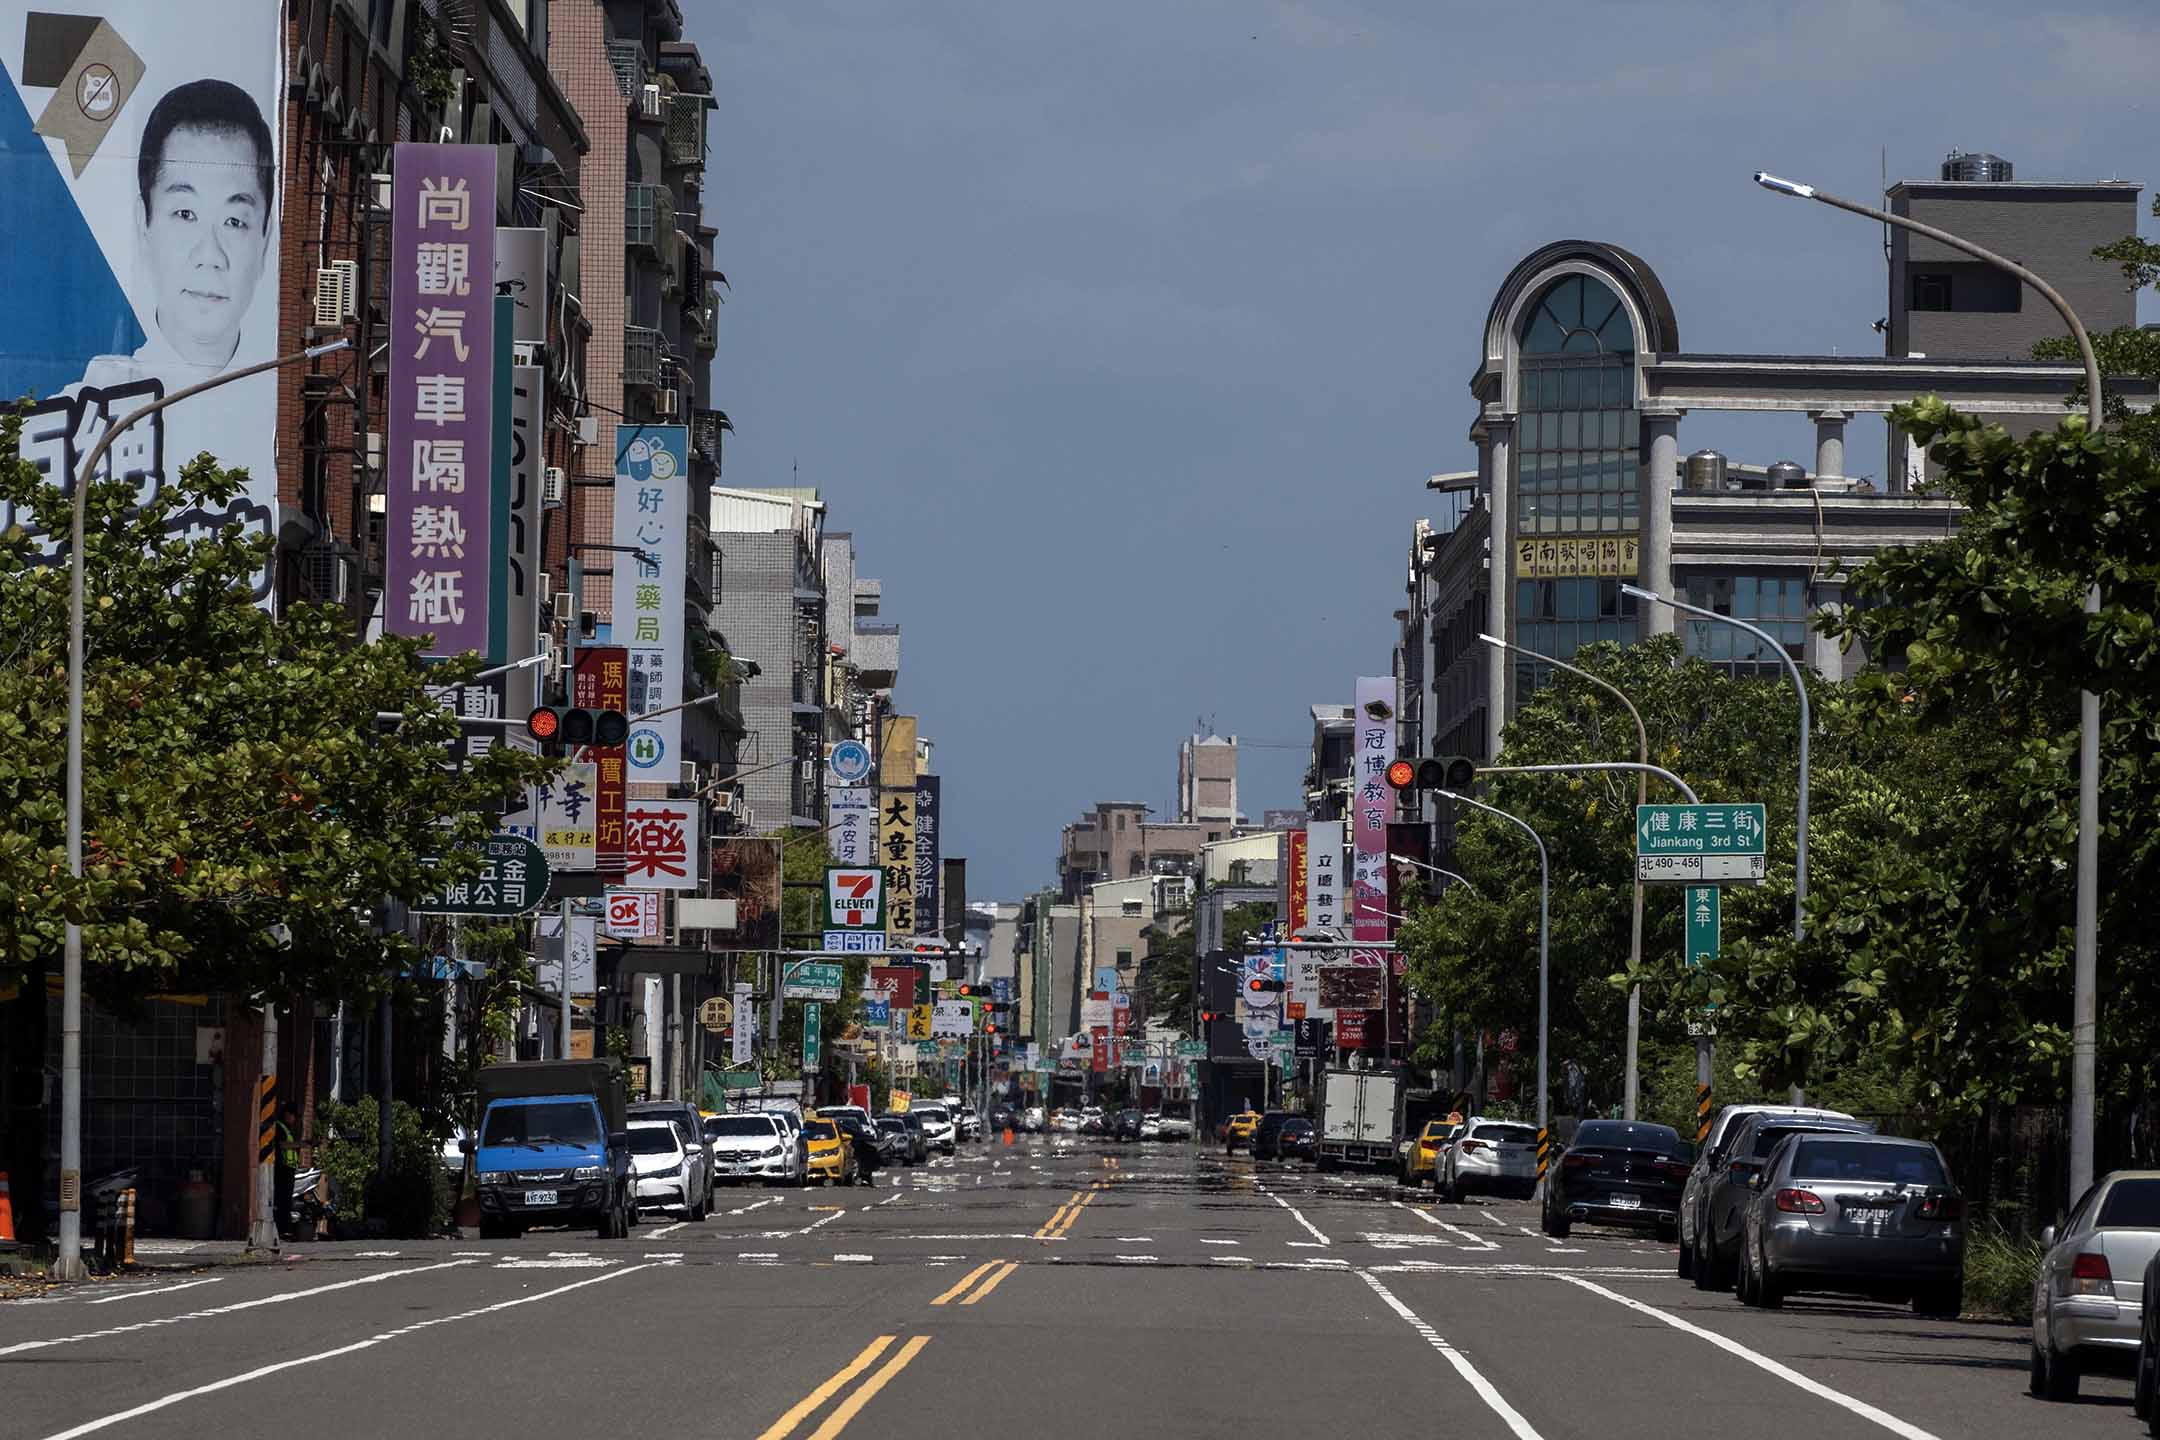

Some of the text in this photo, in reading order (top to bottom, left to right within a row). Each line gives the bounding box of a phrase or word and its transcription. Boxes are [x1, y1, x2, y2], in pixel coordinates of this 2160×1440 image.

[409, 176, 470, 626] 尚觀汽車隔熱紙
[635, 487, 665, 643] 好心情藥局
[1519, 540, 1638, 562] 台南歌唱協會
[600, 661, 624, 845] 瑪亞寶工坊
[1363, 728, 1386, 830] 冠博教育
[626, 807, 688, 878] 藥
[842, 813, 859, 864] 家安牙
[1649, 810, 1753, 832] 健康三街
[1650, 835, 1754, 850] Jiankang 3rd St.
[883, 796, 914, 930] 大童鎖店
[1640, 858, 1700, 871] 北 490-456
[1750, 856, 1763, 870] 南
[610, 902, 639, 920] OK
